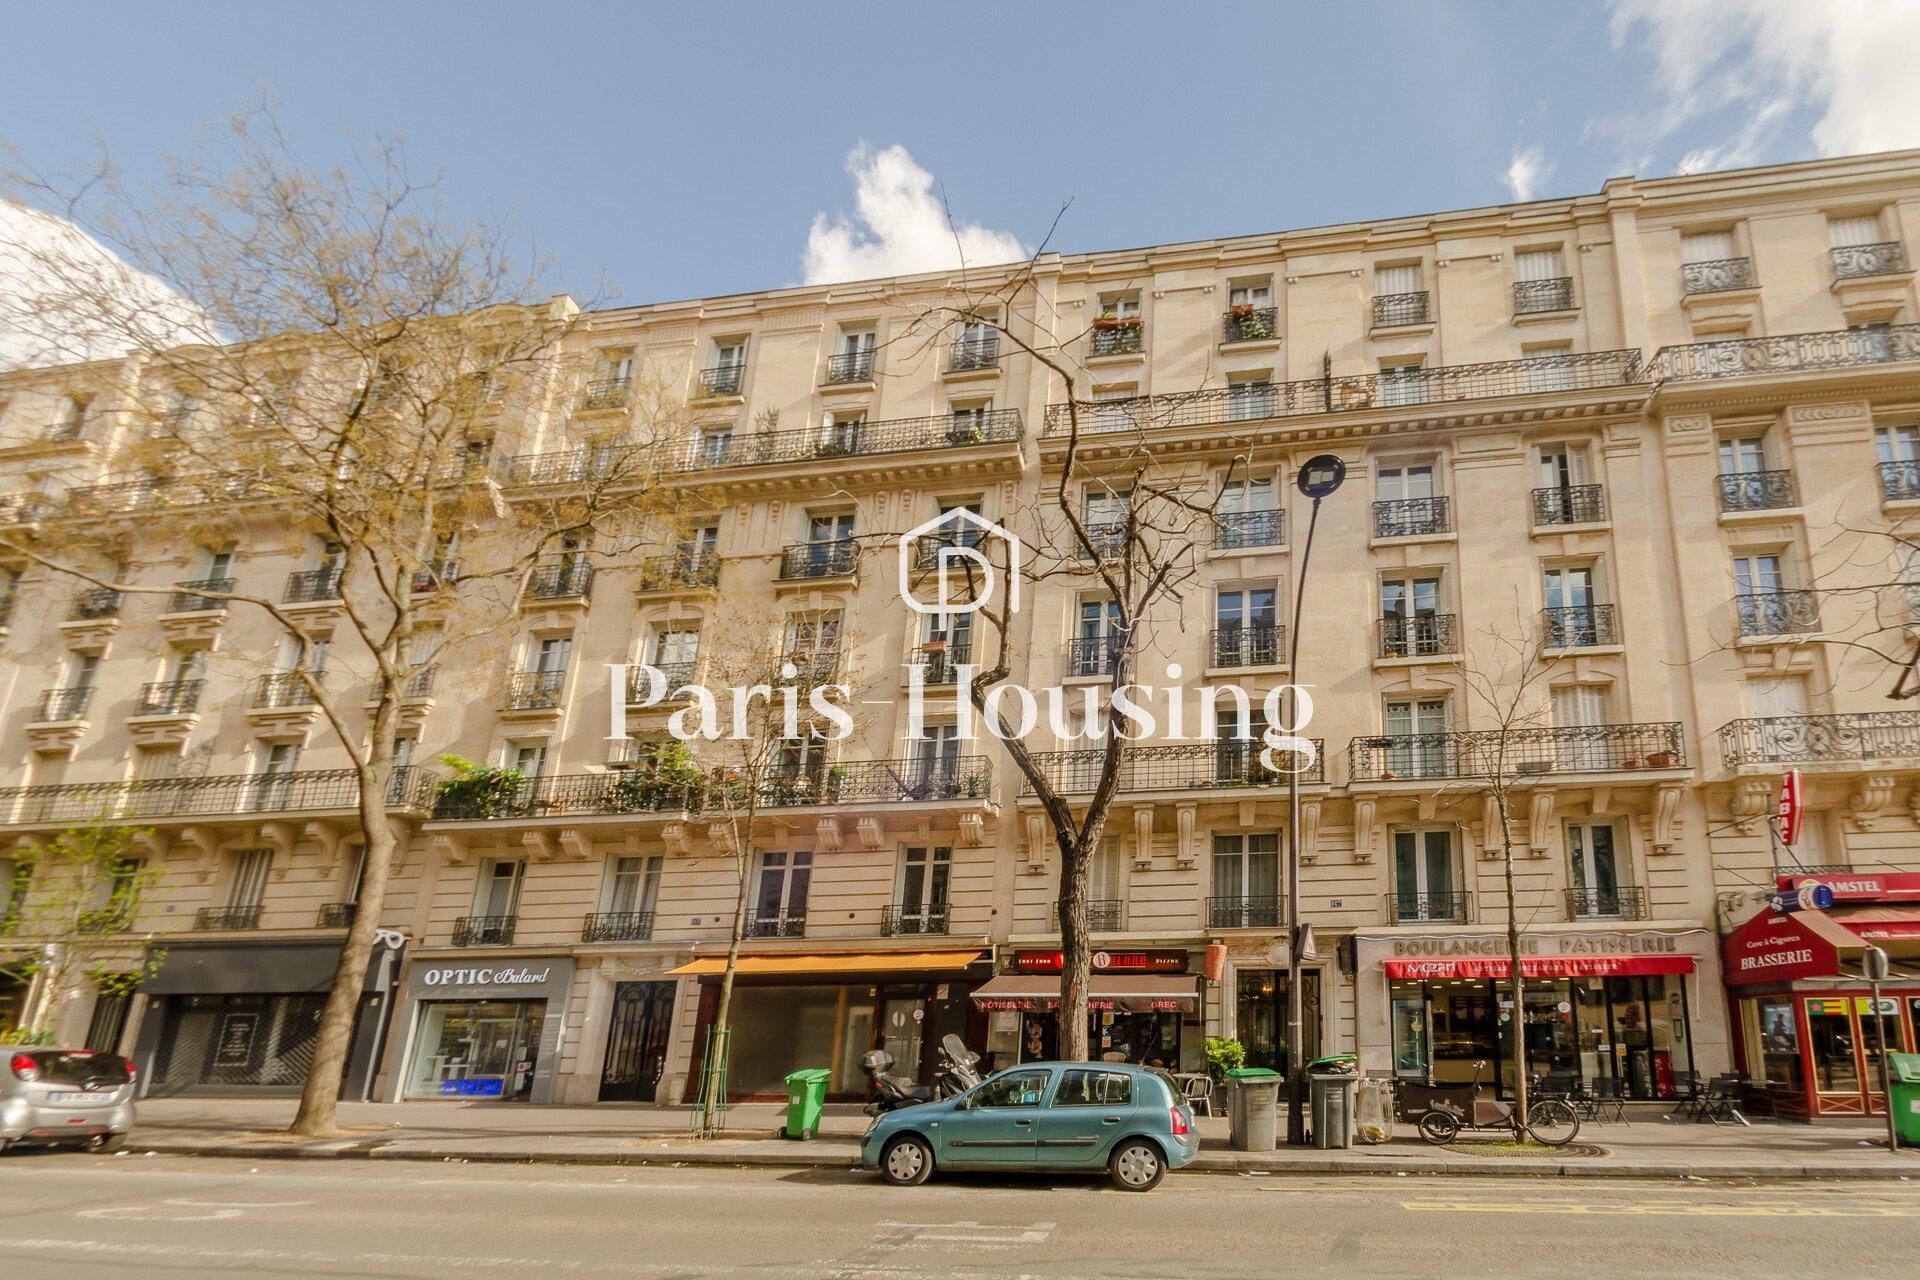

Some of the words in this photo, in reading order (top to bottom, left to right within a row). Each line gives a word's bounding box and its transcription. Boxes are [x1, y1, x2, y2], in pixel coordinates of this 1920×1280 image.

[1779, 773, 1791, 843] TABAC
[1827, 880, 1882, 893] AMSTEL
[1746, 940, 1763, 949] Cave
[1769, 935, 1801, 946] Cigares
[1860, 930, 1890, 938] AMSTEL
[1394, 939, 1539, 956] BOULANGEIE
[1559, 936, 1676, 953] PATISSERIE
[1740, 949, 1812, 970] BRASSERIE
[424, 968, 493, 986] OPTIC
[493, 967, 550, 985] Balard
[1151, 1001, 1177, 1009] GREC
